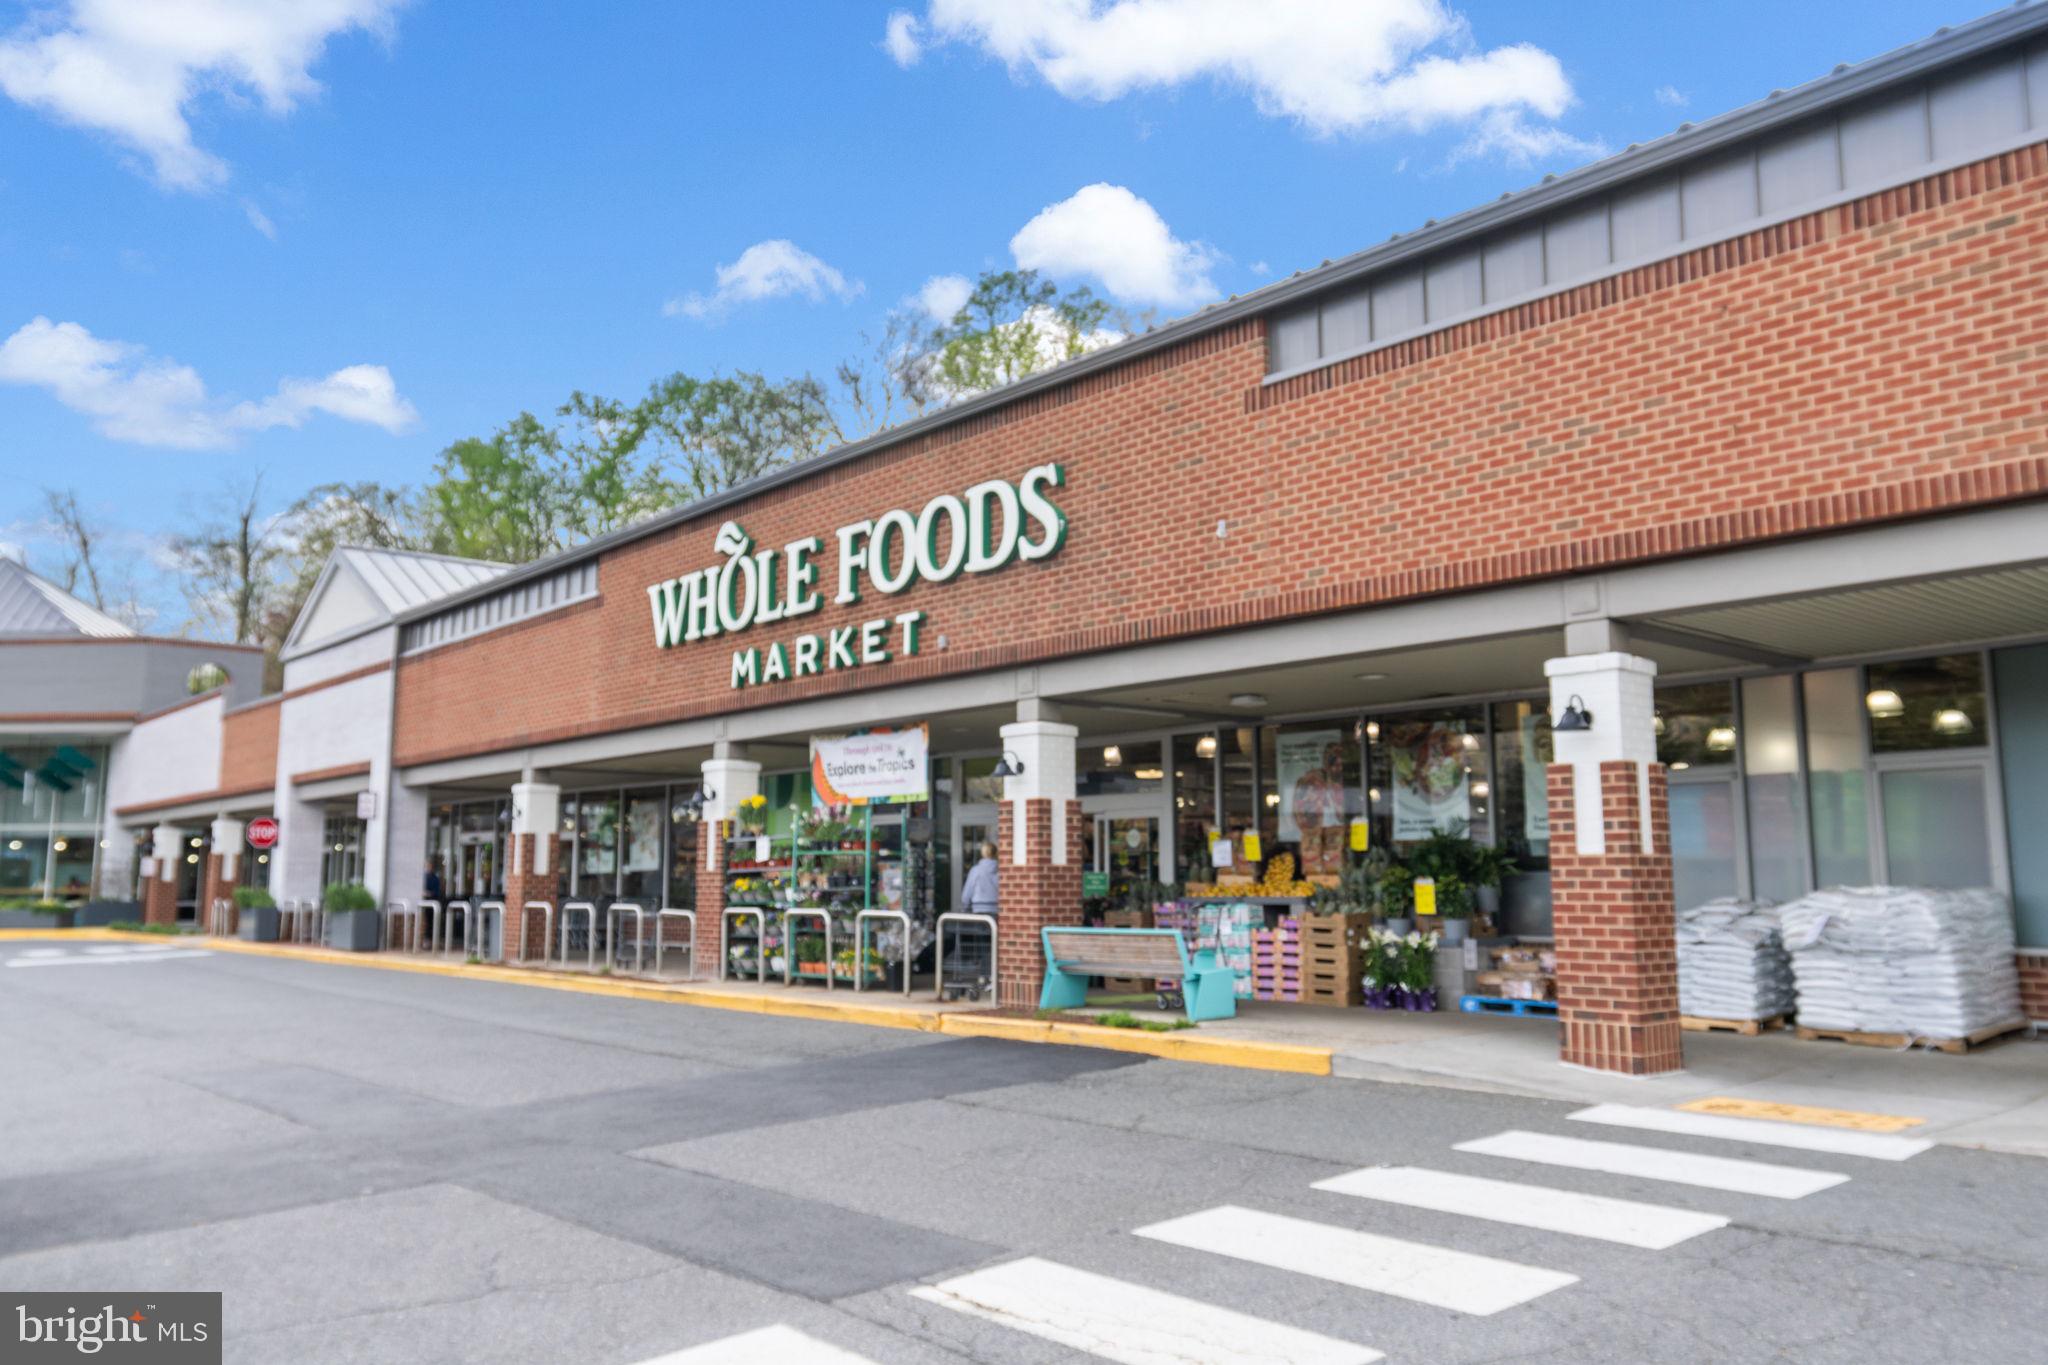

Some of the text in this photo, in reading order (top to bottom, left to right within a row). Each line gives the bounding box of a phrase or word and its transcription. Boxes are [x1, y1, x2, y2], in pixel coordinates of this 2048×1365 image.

[647, 462, 1068, 649] WHOLE FOODS
[730, 610, 926, 689] MARKET
[827, 761, 866, 779] Explore
[249, 826, 275, 839] STOP
